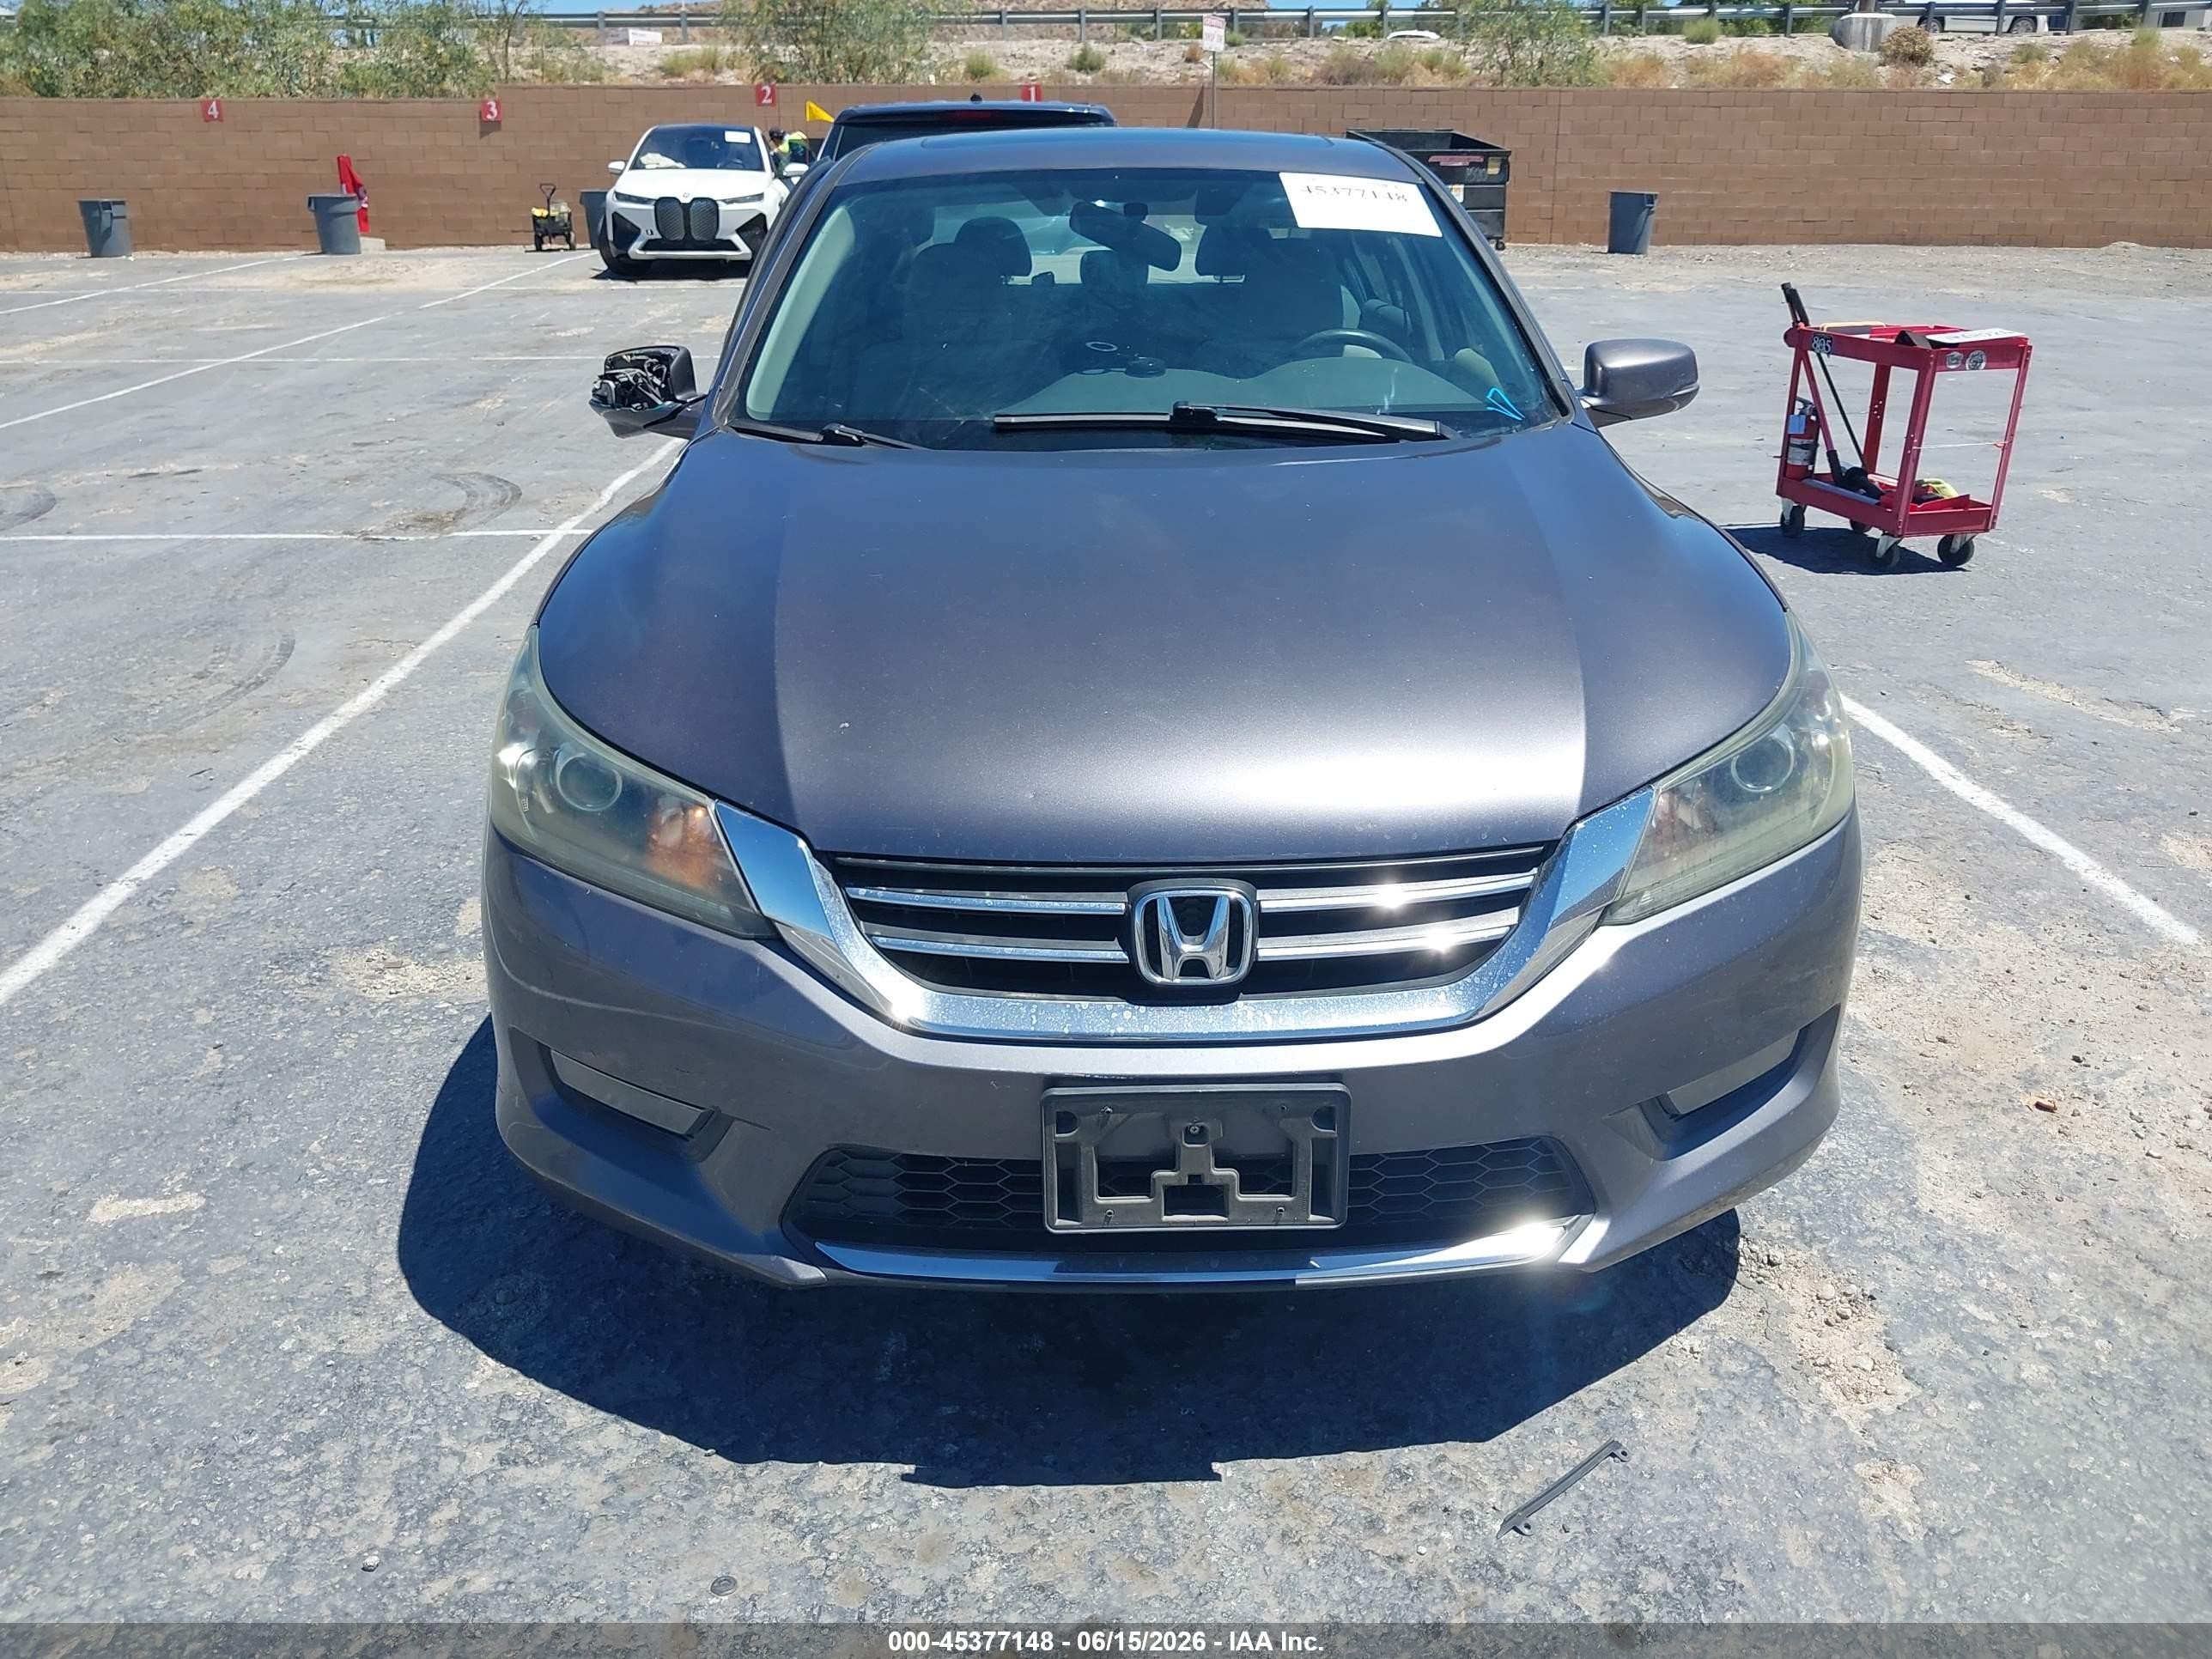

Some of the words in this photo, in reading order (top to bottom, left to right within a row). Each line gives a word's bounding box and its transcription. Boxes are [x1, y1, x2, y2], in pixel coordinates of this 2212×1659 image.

[761, 86, 773, 104] 2
[1029, 86, 1036, 103] 1
[207, 100, 219, 118] 4
[486, 100, 498, 121] 3
[1812, 336, 1832, 353] 805
